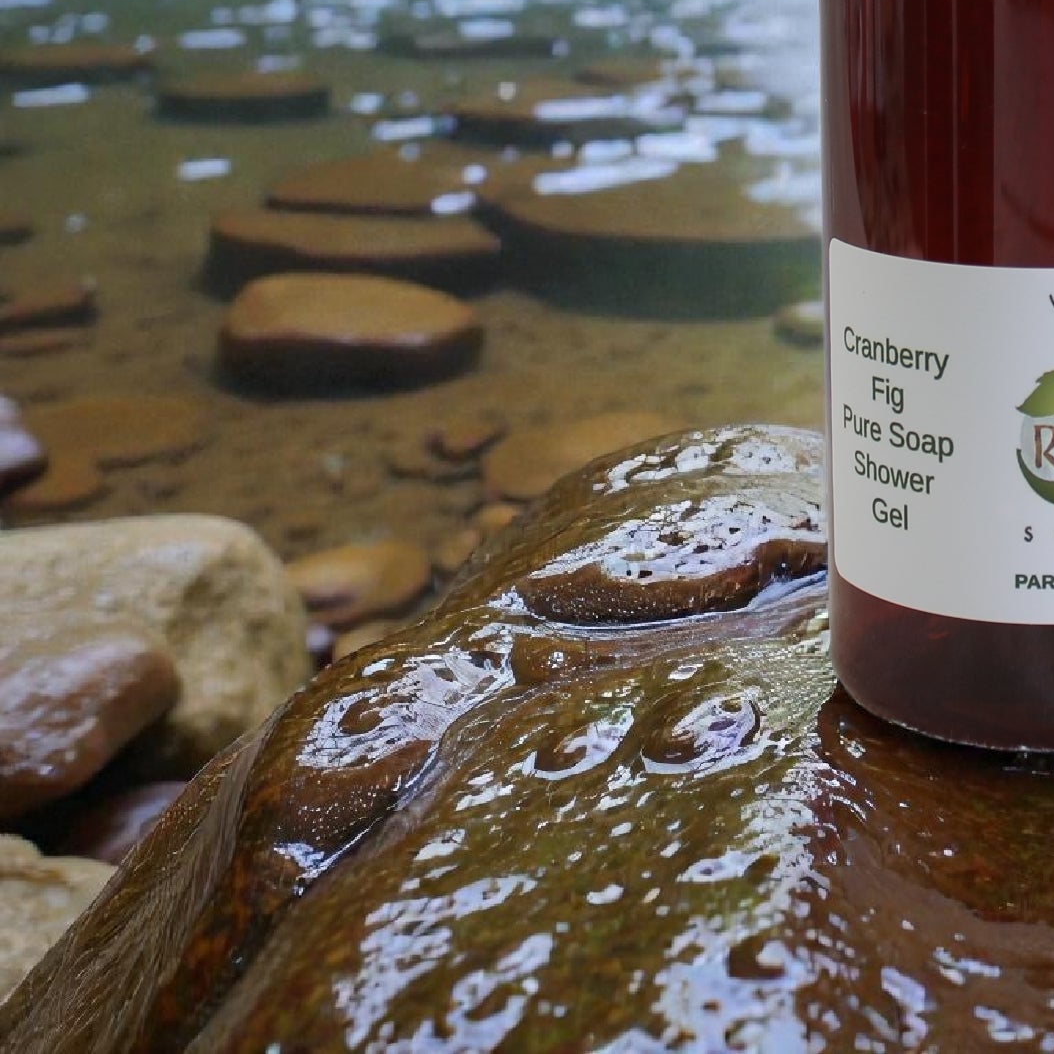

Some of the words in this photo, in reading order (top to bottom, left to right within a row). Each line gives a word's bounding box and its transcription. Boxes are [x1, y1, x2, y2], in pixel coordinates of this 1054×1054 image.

[843, 326, 949, 380] Cranberry
[872, 375, 904, 414] Fig
[843, 403, 882, 442] Pure
[889, 422, 954, 463] Soap
[854, 450, 935, 494] Shower
[872, 497, 908, 531] Gel
